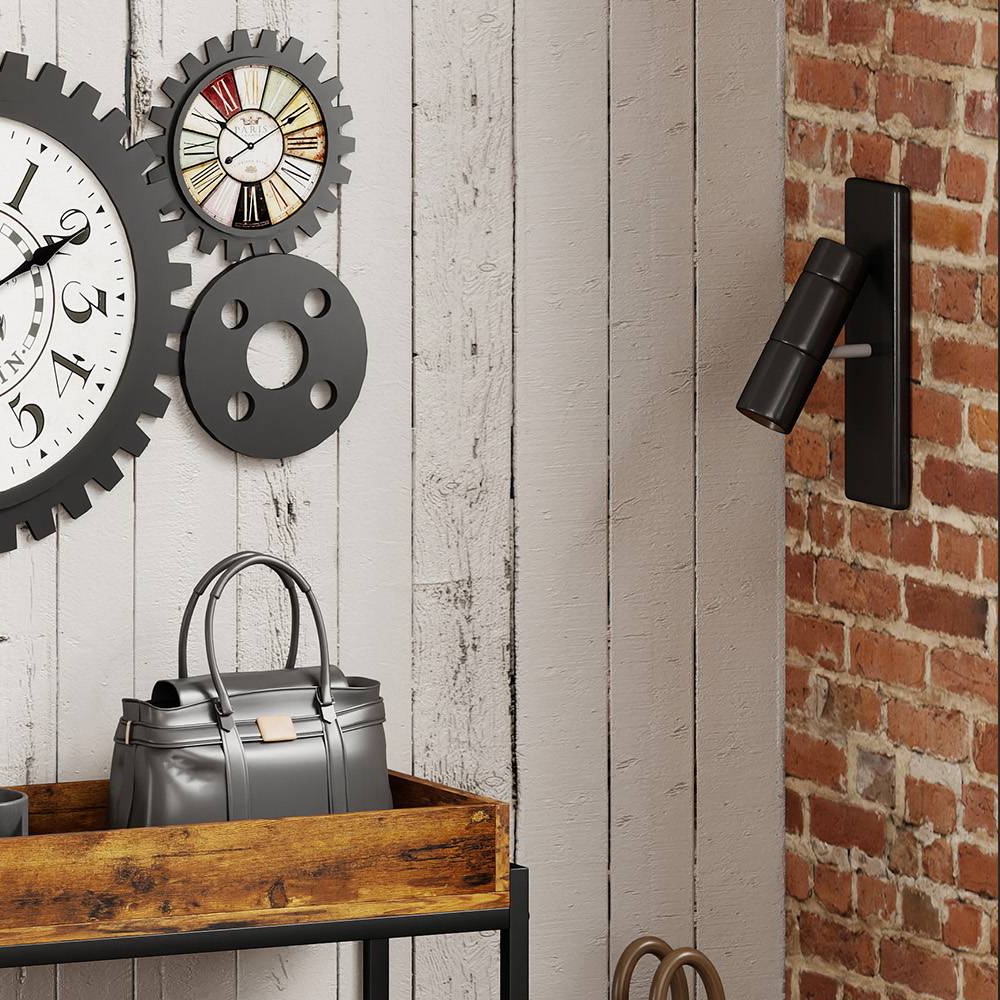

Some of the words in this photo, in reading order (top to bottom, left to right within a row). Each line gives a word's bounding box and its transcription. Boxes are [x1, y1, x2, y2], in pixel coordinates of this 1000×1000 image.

[211, 79, 239, 116] XI
[183, 141, 215, 156] IX
[287, 136, 318, 151] III
[3, 159, 39, 214] 1
[43, 208, 91, 257] 2
[61, 281, 109, 324] 3
[51, 349, 96, 399] 4
[8, 392, 45, 449] 5
